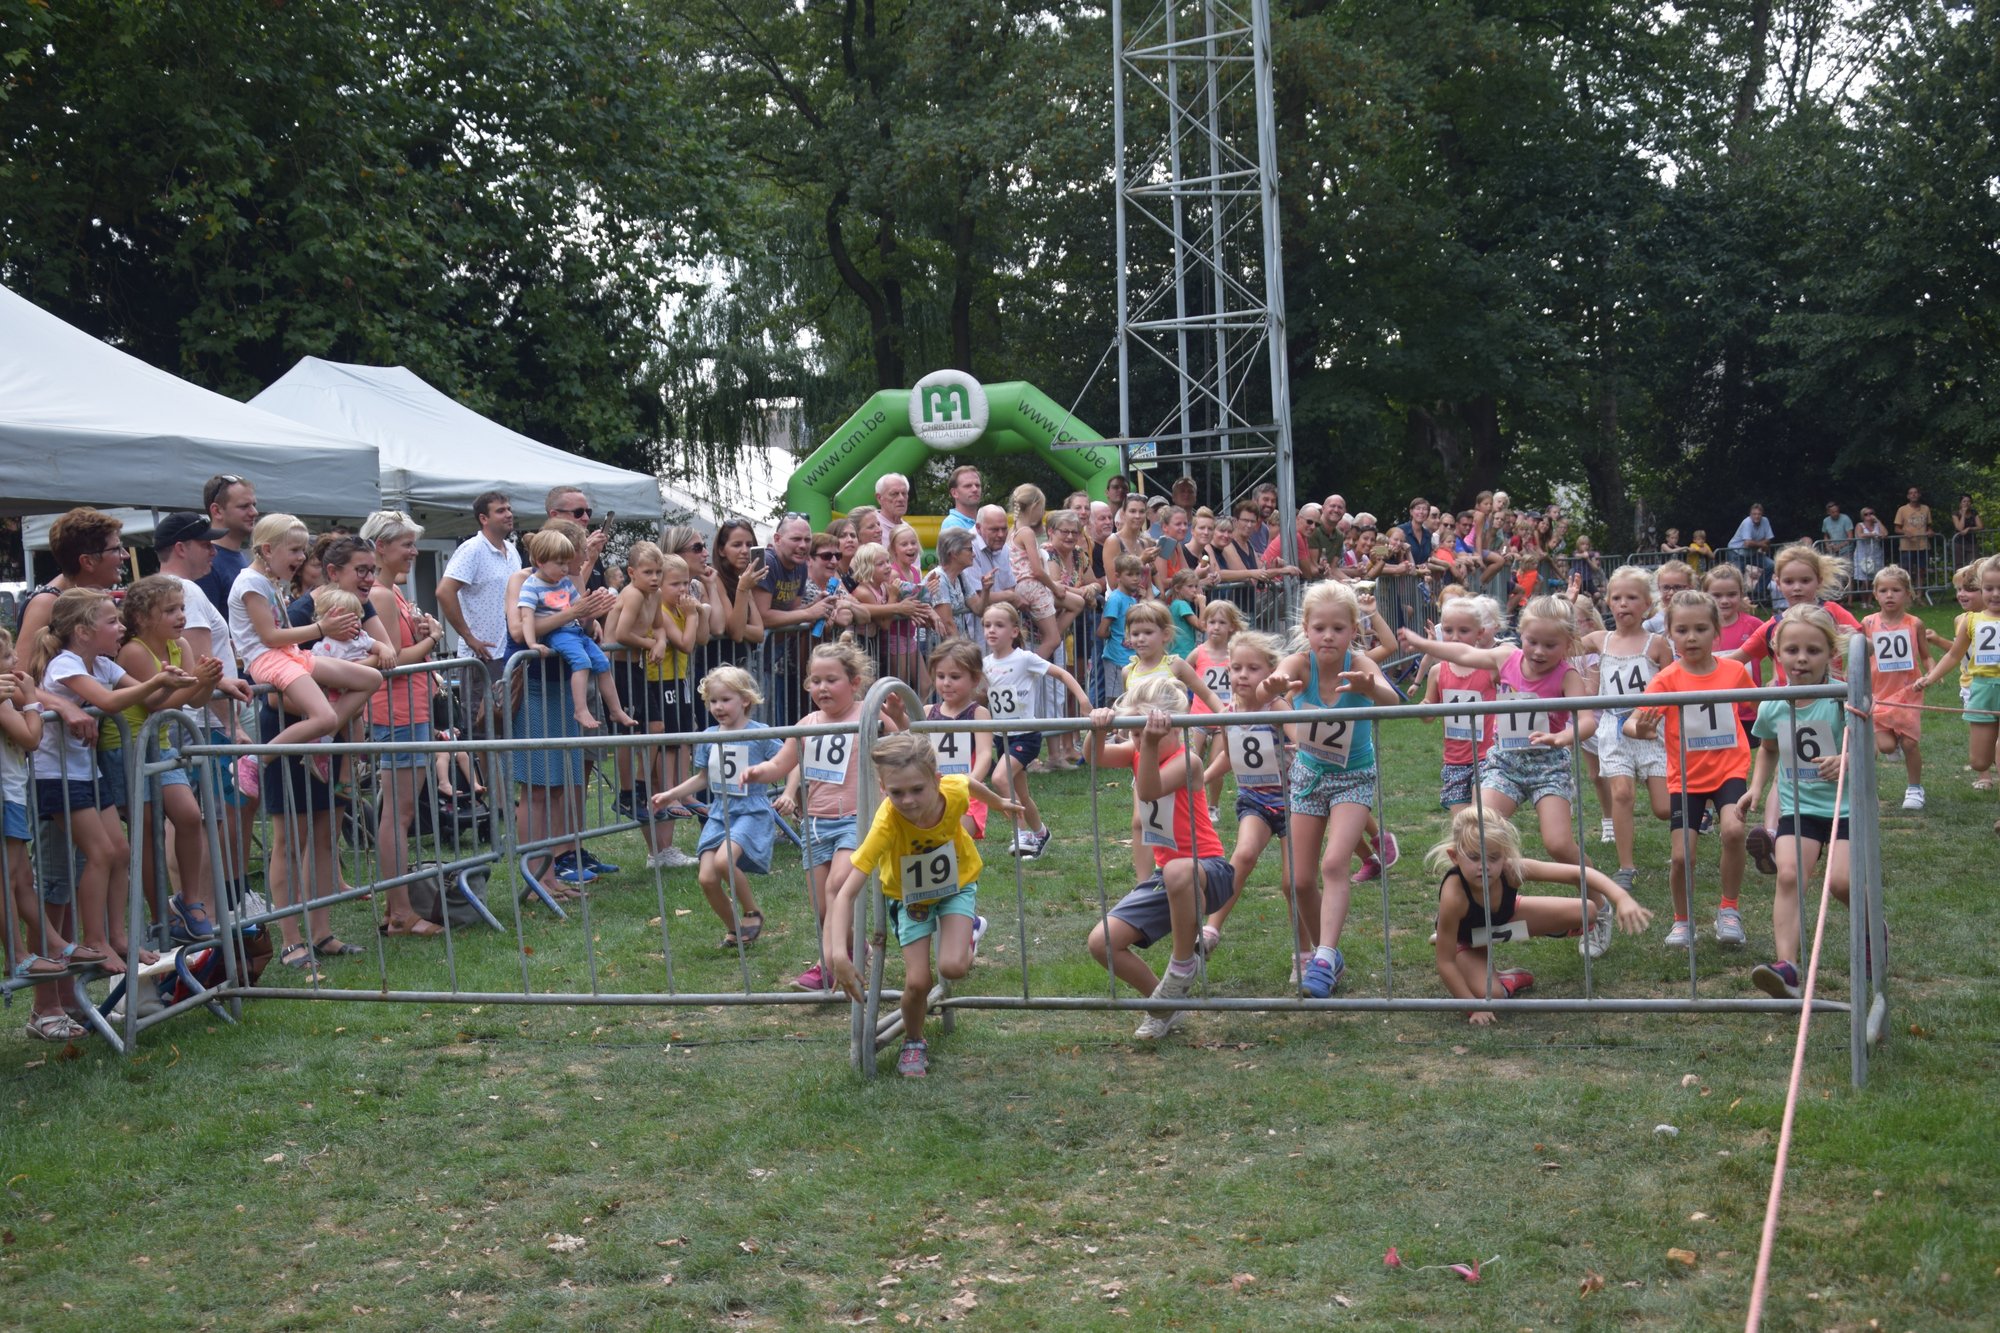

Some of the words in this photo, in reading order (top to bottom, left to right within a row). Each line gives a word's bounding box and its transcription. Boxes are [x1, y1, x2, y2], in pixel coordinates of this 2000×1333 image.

[921, 421, 972, 431] CHRISTELIJKE
[803, 410, 886, 486] www.cm.be
[1877, 635, 1908, 659] 20
[1979, 625, 2000, 651] 2
[1206, 669, 1231, 690] 24
[1609, 665, 1647, 695] 14
[990, 690, 1016, 713] 33
[1699, 703, 1717, 730] 1
[938, 732, 958, 758] 4
[1309, 720, 1346, 749] 12
[1795, 727, 1821, 763] 6
[811, 734, 846, 765] 18
[1242, 736, 1263, 769] 8
[723, 751, 737, 779] 5
[1145, 799, 1163, 830] 2
[907, 854, 951, 888] 19
